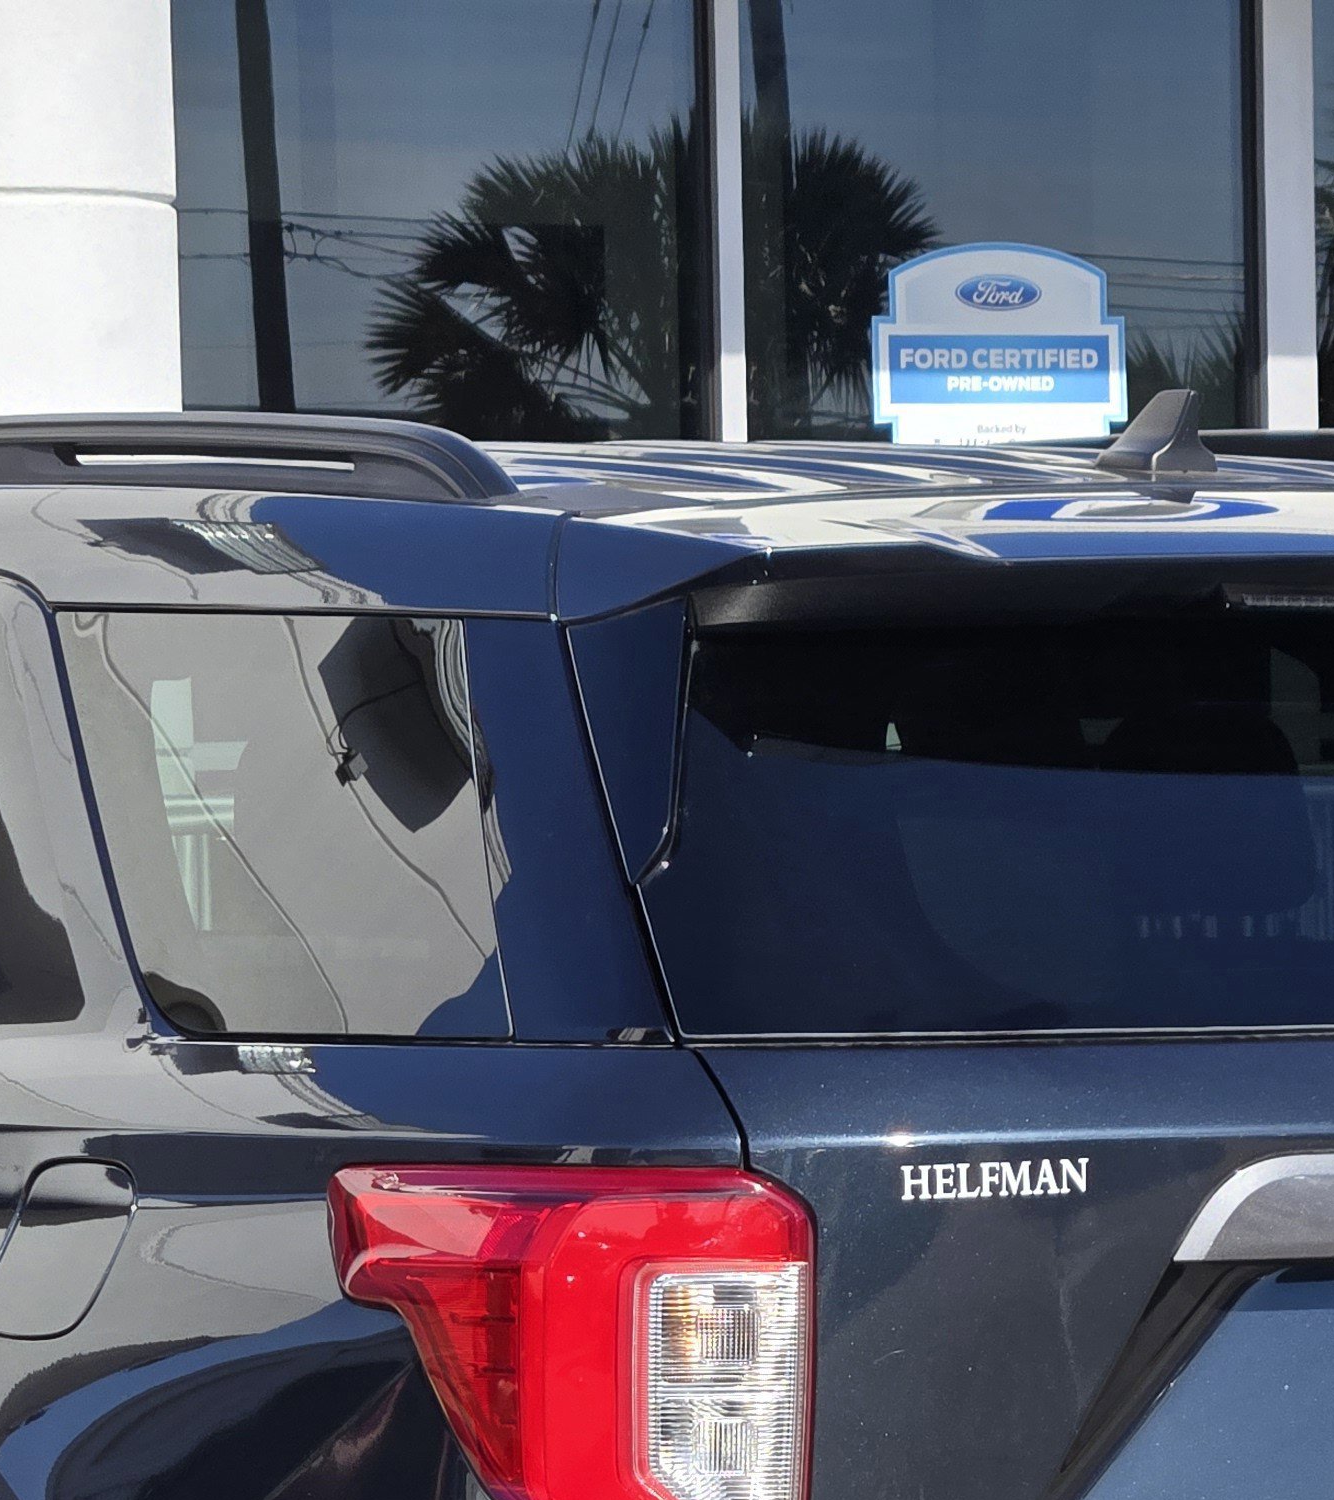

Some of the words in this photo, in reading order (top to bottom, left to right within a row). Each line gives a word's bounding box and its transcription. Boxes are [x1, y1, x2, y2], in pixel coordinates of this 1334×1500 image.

[972, 279, 1024, 305] Ford
[899, 348, 967, 369] FORD
[972, 348, 1099, 369] CERTIFIED
[946, 375, 1055, 392] PRE-OWNED
[1014, 423, 1027, 435] by
[900, 1157, 1090, 1201] HELFMAN
